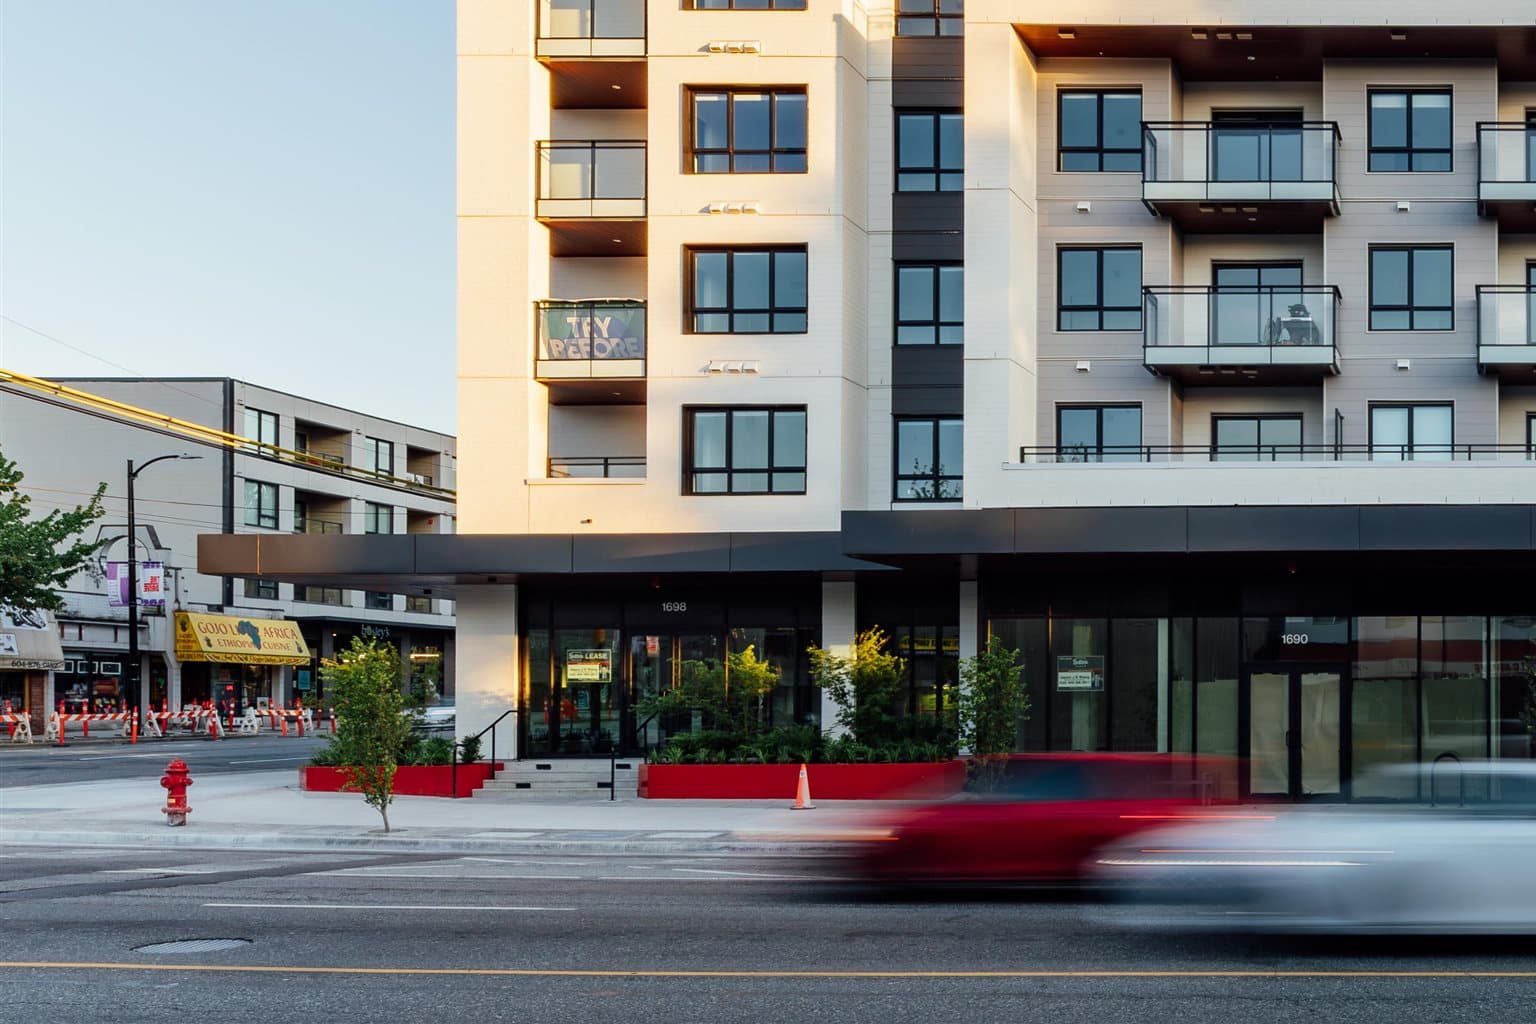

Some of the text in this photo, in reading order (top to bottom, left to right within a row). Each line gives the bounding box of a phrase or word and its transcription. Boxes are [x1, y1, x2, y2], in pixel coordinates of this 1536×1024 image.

[566, 316, 611, 338] TRY
[549, 336, 641, 359] BEFORE
[662, 601, 687, 612] 1698
[198, 621, 228, 636] GOJO
[263, 627, 298, 640] AFRICA
[1281, 633, 1309, 645] 1690
[585, 652, 608, 660] LEASE
